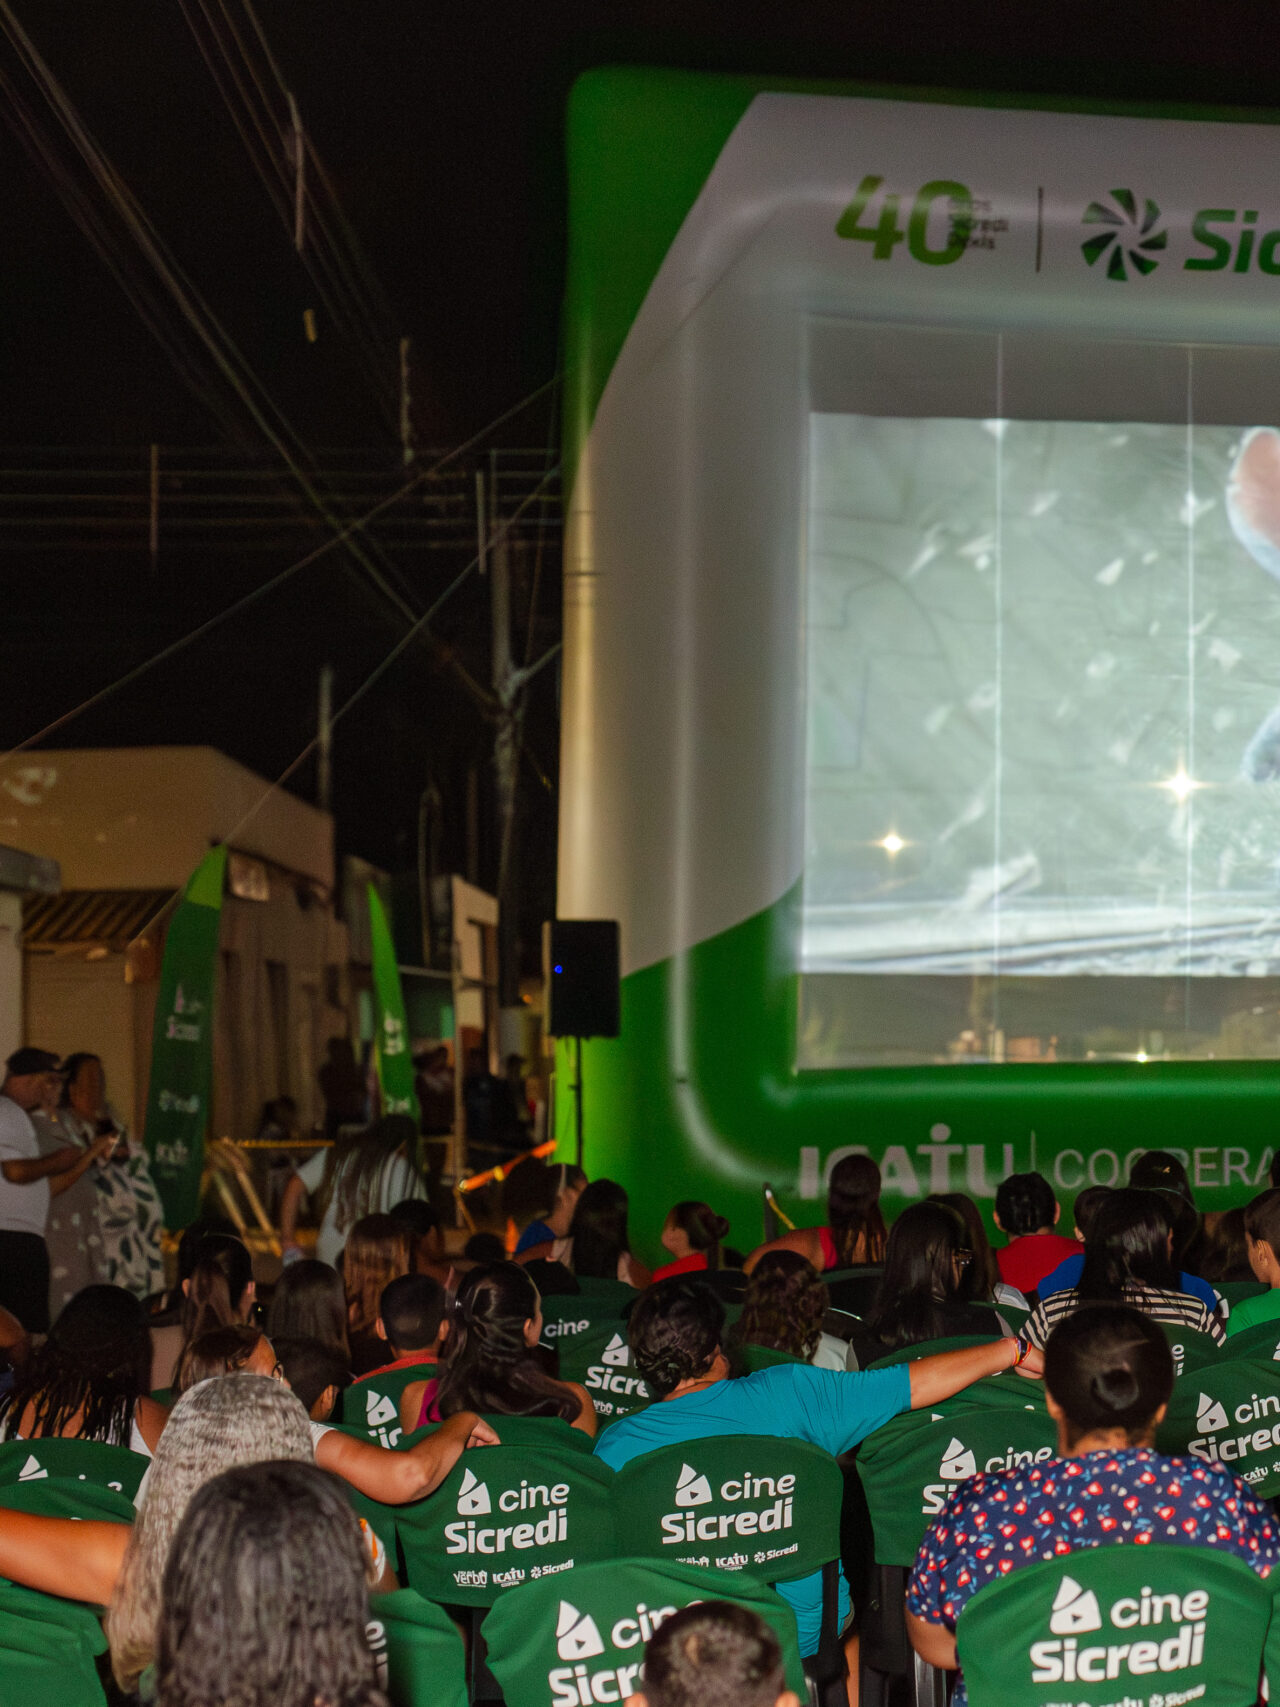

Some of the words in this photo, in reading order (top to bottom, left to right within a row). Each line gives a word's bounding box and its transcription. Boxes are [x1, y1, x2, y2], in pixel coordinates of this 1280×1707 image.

[834, 174, 973, 266] 40
[585, 1366, 649, 1398] Sicre
[499, 1479, 570, 1512] cine
[720, 1472, 796, 1501] cine
[444, 1508, 568, 1554] Sicredi
[661, 1496, 794, 1544] Sicredi
[492, 1567, 526, 1584] ICATU
[542, 1559, 575, 1576] Sicredi
[715, 1552, 748, 1568] ICATU
[766, 1543, 799, 1560] Sicredi
[1110, 1585, 1209, 1629] cine
[1029, 1621, 1206, 1683] Sicredi
